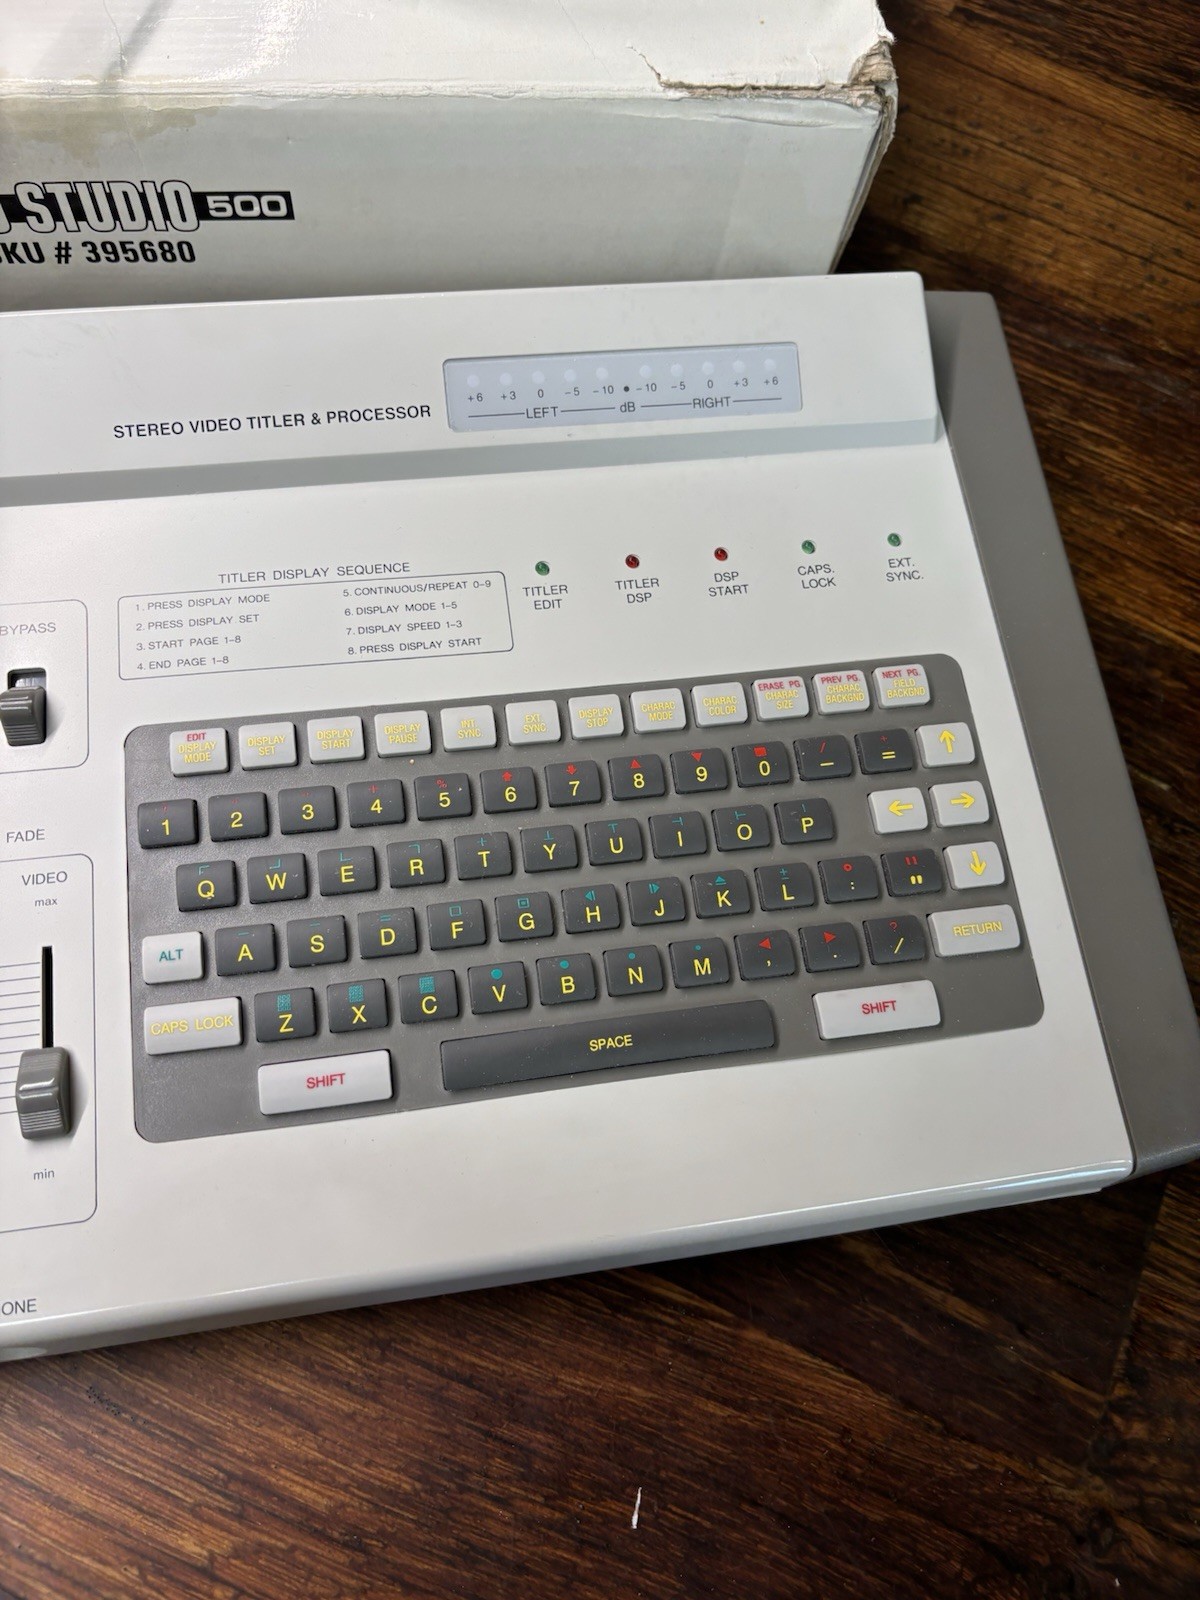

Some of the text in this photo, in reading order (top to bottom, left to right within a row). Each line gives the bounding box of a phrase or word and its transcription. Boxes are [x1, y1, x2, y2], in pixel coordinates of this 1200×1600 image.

[14, 180, 200, 234] STUDIO
[207, 194, 289, 218] 500
[0, 240, 196, 264] KU # 395680
[537, 388, 544, 399] 0
[707, 379, 714, 389] 0
[526, 396, 732, 419] LEFT dB RIGHT
[113, 405, 431, 438] STEREO VIDEO TITLER & PROCESSOR
[797, 563, 835, 576] CAPS.
[888, 557, 915, 569] EXT.
[218, 562, 410, 584] TITLER DISPLAY SEQUENCE
[714, 571, 739, 583] DSP
[886, 569, 924, 583] SYNC.
[354, 580, 467, 596] CONTINUOUS/REPEAT
[522, 584, 568, 598] TITLER
[615, 577, 660, 591] TITLER
[708, 584, 749, 597] START
[801, 576, 836, 590] LOCK
[147, 600, 183, 610] PRESS
[188, 596, 232, 607] DISPLAY
[238, 593, 270, 604] MODE
[533, 599, 562, 611] EDIT
[626, 591, 652, 604] DSP
[356, 605, 399, 615] DISPLAY
[405, 602, 436, 612] MODE
[0, 621, 56, 636] BYPASS
[148, 619, 183, 630] PRESS
[188, 616, 233, 627] DISPLAY
[239, 614, 260, 624] SET
[358, 624, 401, 635] DISPLAY
[407, 621, 441, 632] SPEED
[148, 639, 184, 650] START
[190, 636, 218, 646] PAGE
[359, 643, 394, 654] PRESS
[399, 640, 443, 651] DISPLAY
[448, 637, 482, 648] START
[149, 659, 171, 670] END
[177, 657, 207, 667] PAGE
[820, 674, 861, 684] PREV PG.
[881, 668, 921, 679] NEXT PG.
[757, 681, 784, 691] ERASE
[892, 678, 916, 687] FIELD
[825, 693, 865, 704] BACKGND
[887, 687, 926, 698] BACKGND
[578, 707, 613, 719] DISPLAY
[708, 705, 737, 716] COLOR
[776, 700, 793, 710] SIZE
[587, 717, 609, 728] STOP
[648, 711, 673, 722] MODE
[187, 732, 206, 742] EDIT
[317, 728, 355, 741] DISPLAY
[384, 723, 421, 736] DISPLAY
[247, 735, 285, 748] DISPLAY
[321, 738, 351, 750] START
[388, 733, 418, 745] PAUSE
[178, 741, 216, 754] DISPLAY
[258, 746, 276, 756] SET
[184, 751, 211, 763] MODE
[633, 773, 645, 789] 8
[696, 767, 708, 782] 9
[504, 787, 517, 803] 6
[569, 781, 580, 796] 7
[370, 799, 382, 814] 4
[439, 792, 451, 808] 5
[231, 812, 243, 828] 2
[302, 804, 314, 820] 3
[162, 819, 170, 836] 1
[737, 824, 752, 841] O
[801, 818, 814, 834] P
[6, 828, 45, 843] FADE
[677, 831, 683, 847] I
[543, 843, 556, 860] Y
[609, 837, 624, 854] U
[477, 851, 491, 867] T
[341, 865, 355, 883] E
[409, 859, 424, 876] R
[22, 870, 68, 886] VIDEO
[266, 872, 287, 891] W
[197, 880, 215, 898] Q
[782, 884, 795, 901] L
[34, 896, 58, 908] max
[717, 890, 732, 907] K
[585, 906, 601, 923] H
[654, 899, 665, 917] J
[451, 921, 463, 939] F
[518, 913, 535, 931] G
[953, 921, 1003, 937] RETURN
[310, 935, 325, 953] S
[381, 928, 396, 946] D
[159, 949, 183, 962] ALT
[238, 944, 253, 962] A
[693, 957, 711, 976] M
[628, 966, 644, 984] N
[561, 976, 575, 994] B
[492, 985, 506, 1003] V
[421, 996, 437, 1014] C
[862, 1000, 897, 1015] SHIFT
[351, 1005, 367, 1024] X
[150, 1016, 233, 1035] CAPS LOCK
[279, 1014, 294, 1033] Z
[589, 1034, 633, 1052] SPACE
[306, 1072, 346, 1089] SHIFT
[33, 1168, 55, 1180] min
